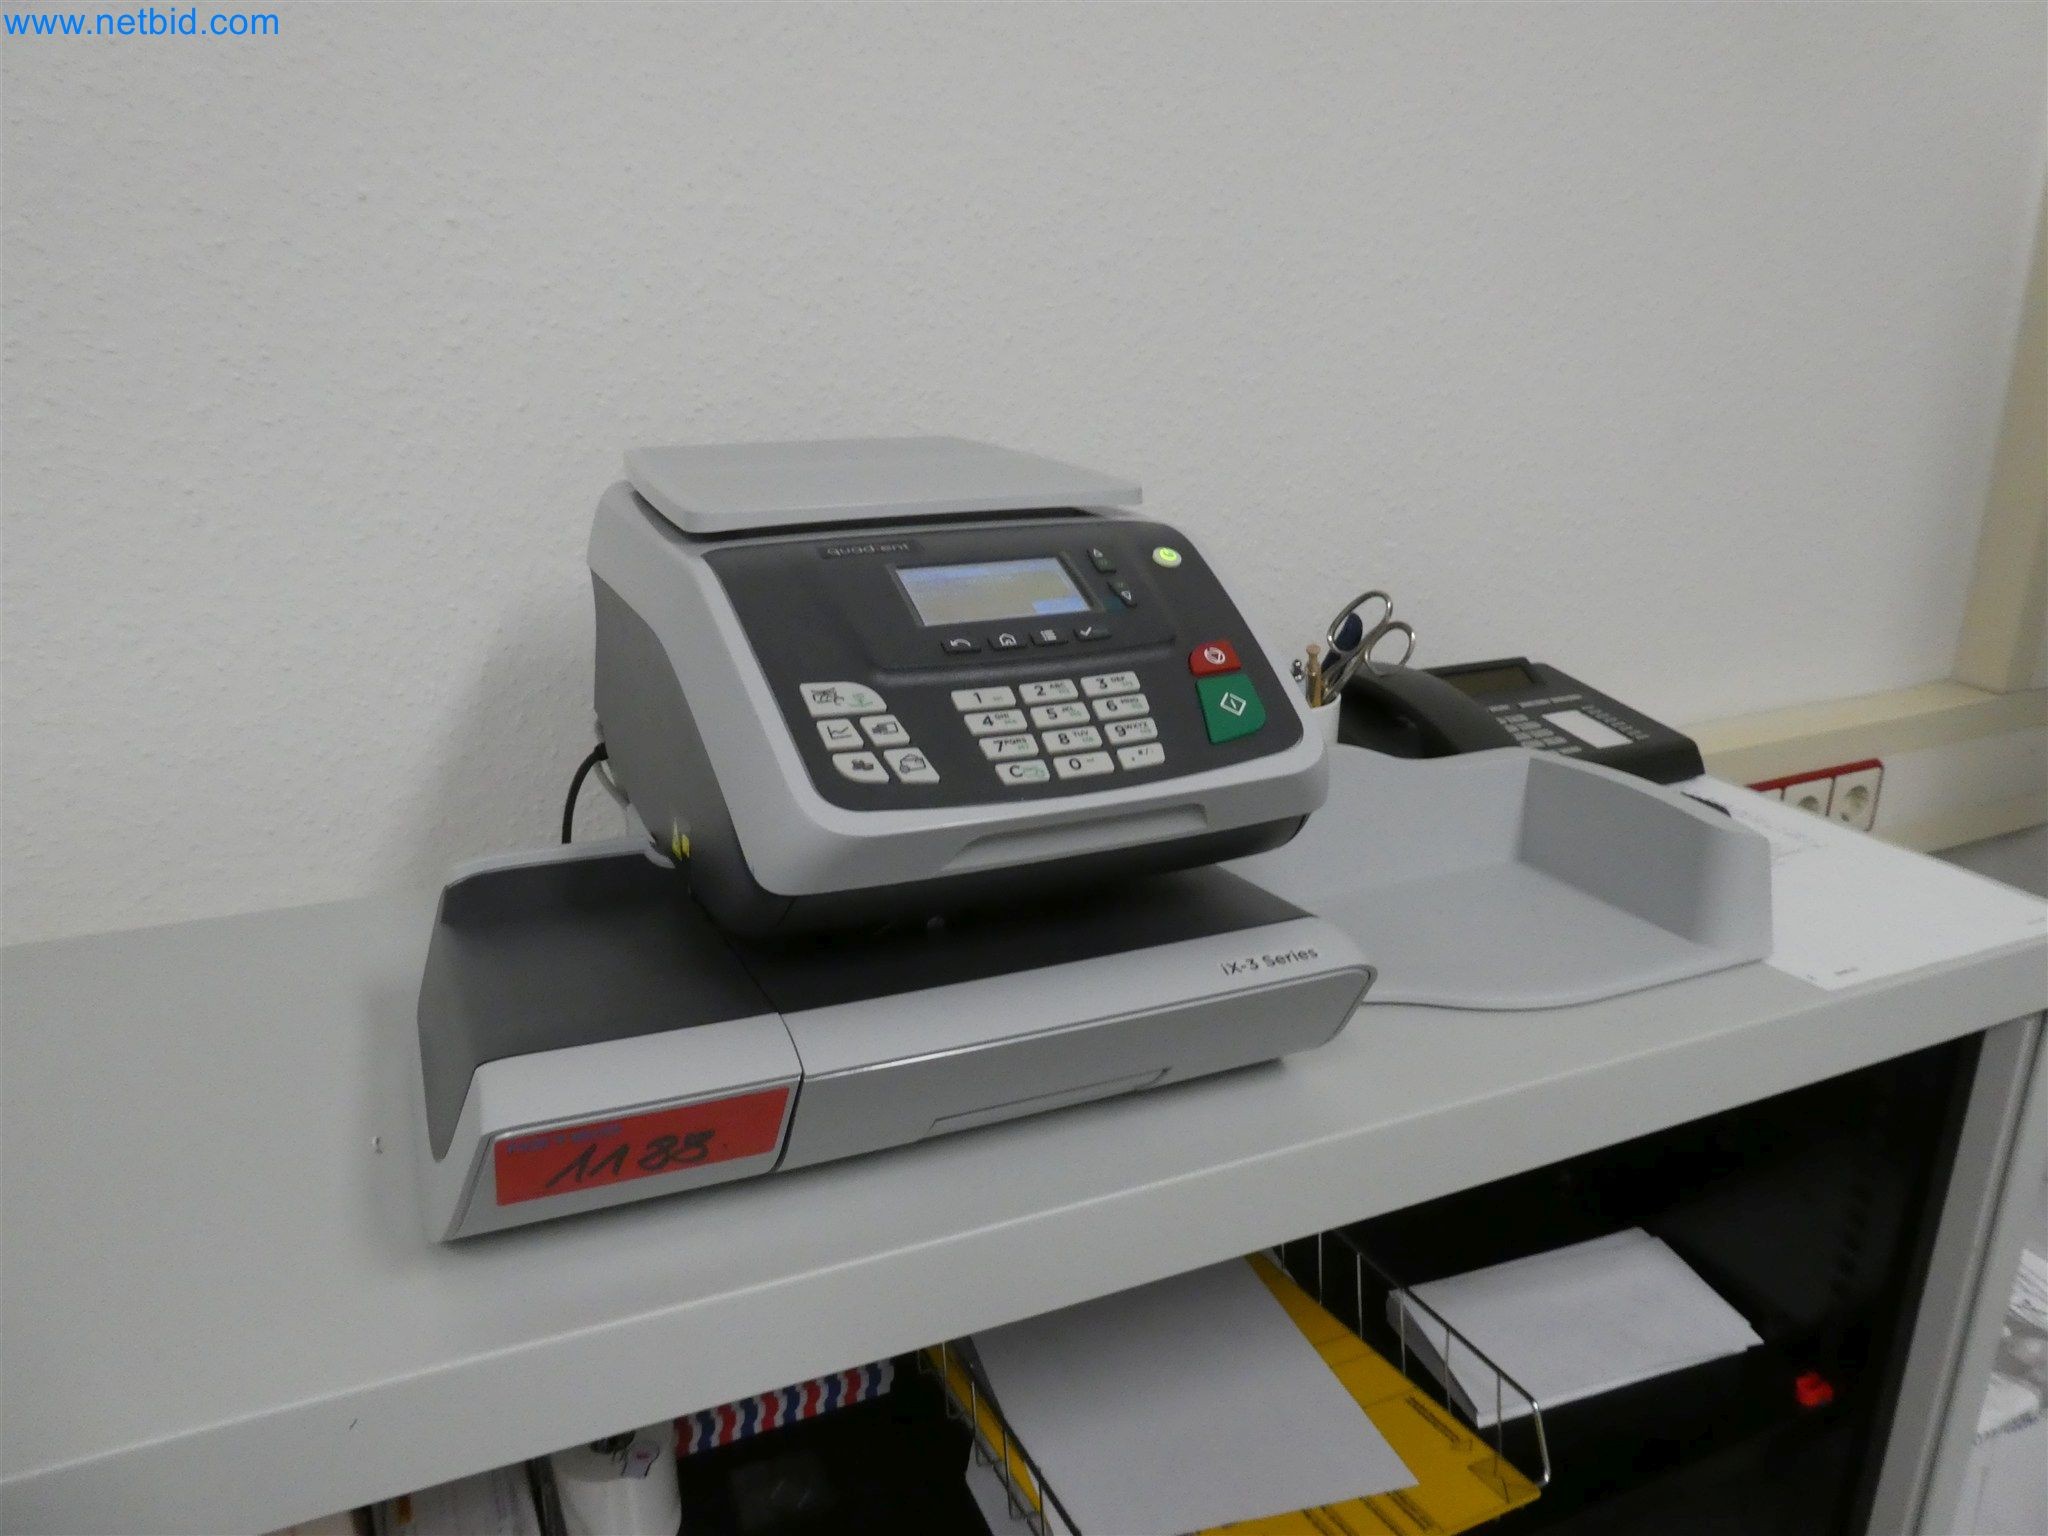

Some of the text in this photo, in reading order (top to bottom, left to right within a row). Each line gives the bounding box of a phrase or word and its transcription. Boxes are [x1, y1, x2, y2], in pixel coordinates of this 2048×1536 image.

[1095, 677, 1108, 690] 3
[973, 691, 983, 704] 1
[1034, 685, 1047, 697] 2
[1106, 700, 1118, 712] 6
[1046, 707, 1058, 720] 5
[983, 715, 994, 727] 4
[1114, 724, 1127, 737] 9
[1058, 733, 1070, 745] 8
[993, 740, 1003, 753] 7
[1009, 765, 1023, 778] C
[1261, 948, 1319, 968] Series
